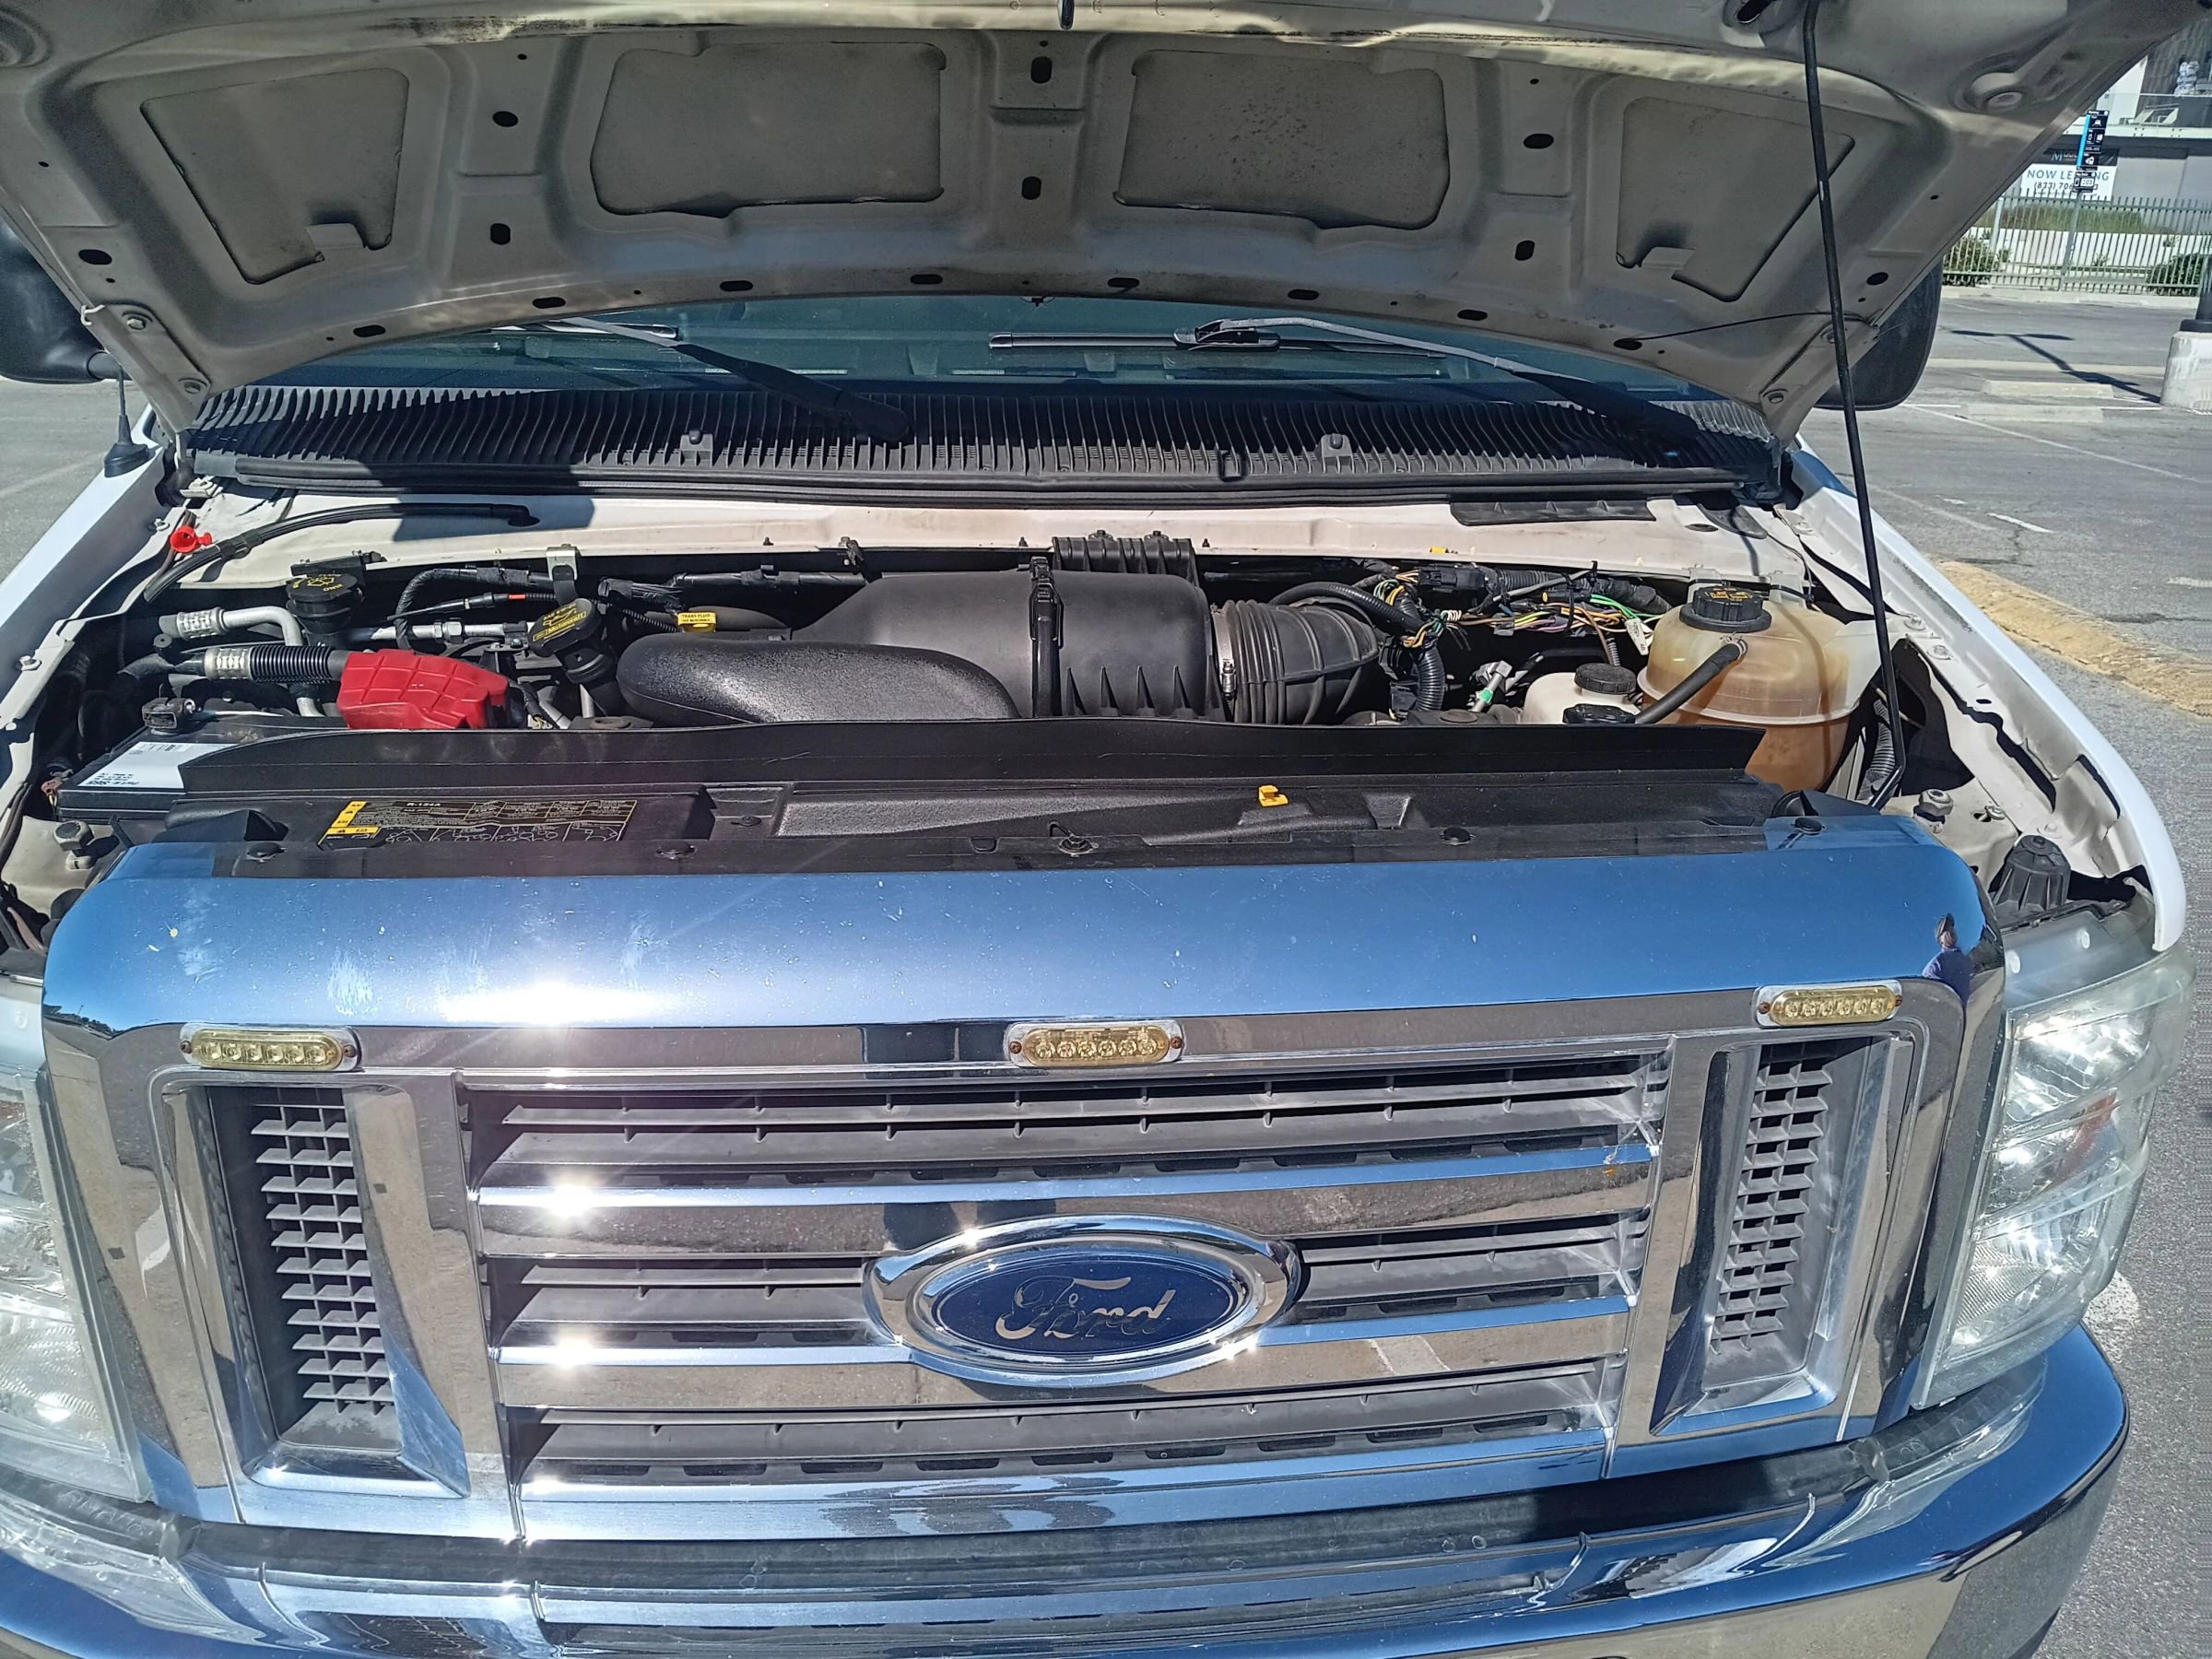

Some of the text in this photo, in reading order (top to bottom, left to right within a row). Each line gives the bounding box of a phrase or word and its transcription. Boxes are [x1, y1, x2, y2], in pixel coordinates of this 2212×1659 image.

[2027, 170, 2109, 181] NOW LENG
[995, 1276, 1176, 1339] Ford
